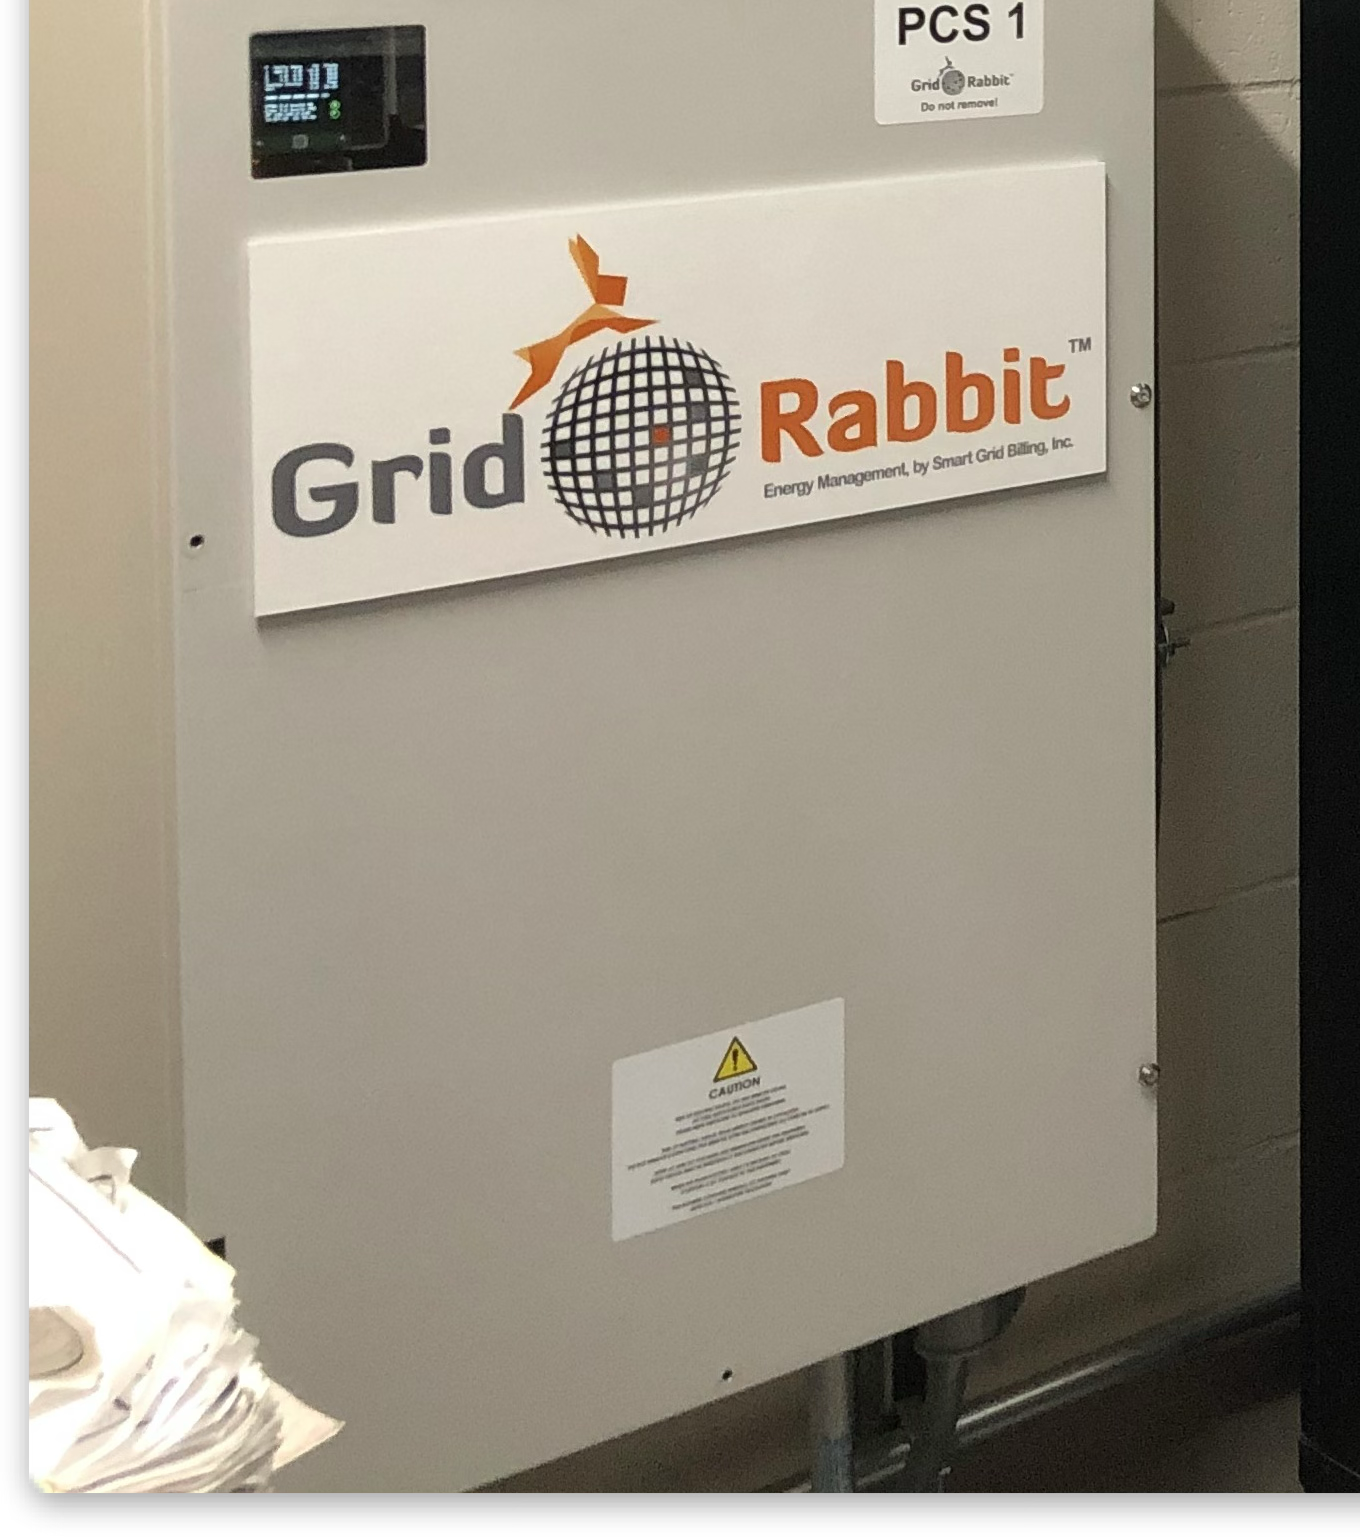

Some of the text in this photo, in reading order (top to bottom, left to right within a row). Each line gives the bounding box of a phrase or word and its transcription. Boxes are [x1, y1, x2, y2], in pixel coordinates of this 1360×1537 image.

[898, 1, 1024, 46] PCS 1
[911, 74, 1010, 92] Grid Rabbit
[921, 102, 935, 112] Do
[938, 101, 955, 111] not
[271, 413, 525, 537] Grid
[760, 346, 1071, 463] Rabbit
[764, 436, 1074, 499] Energy Management, by Smart Grid Billing, Inc.
[708, 1076, 761, 1100] CAUTION
